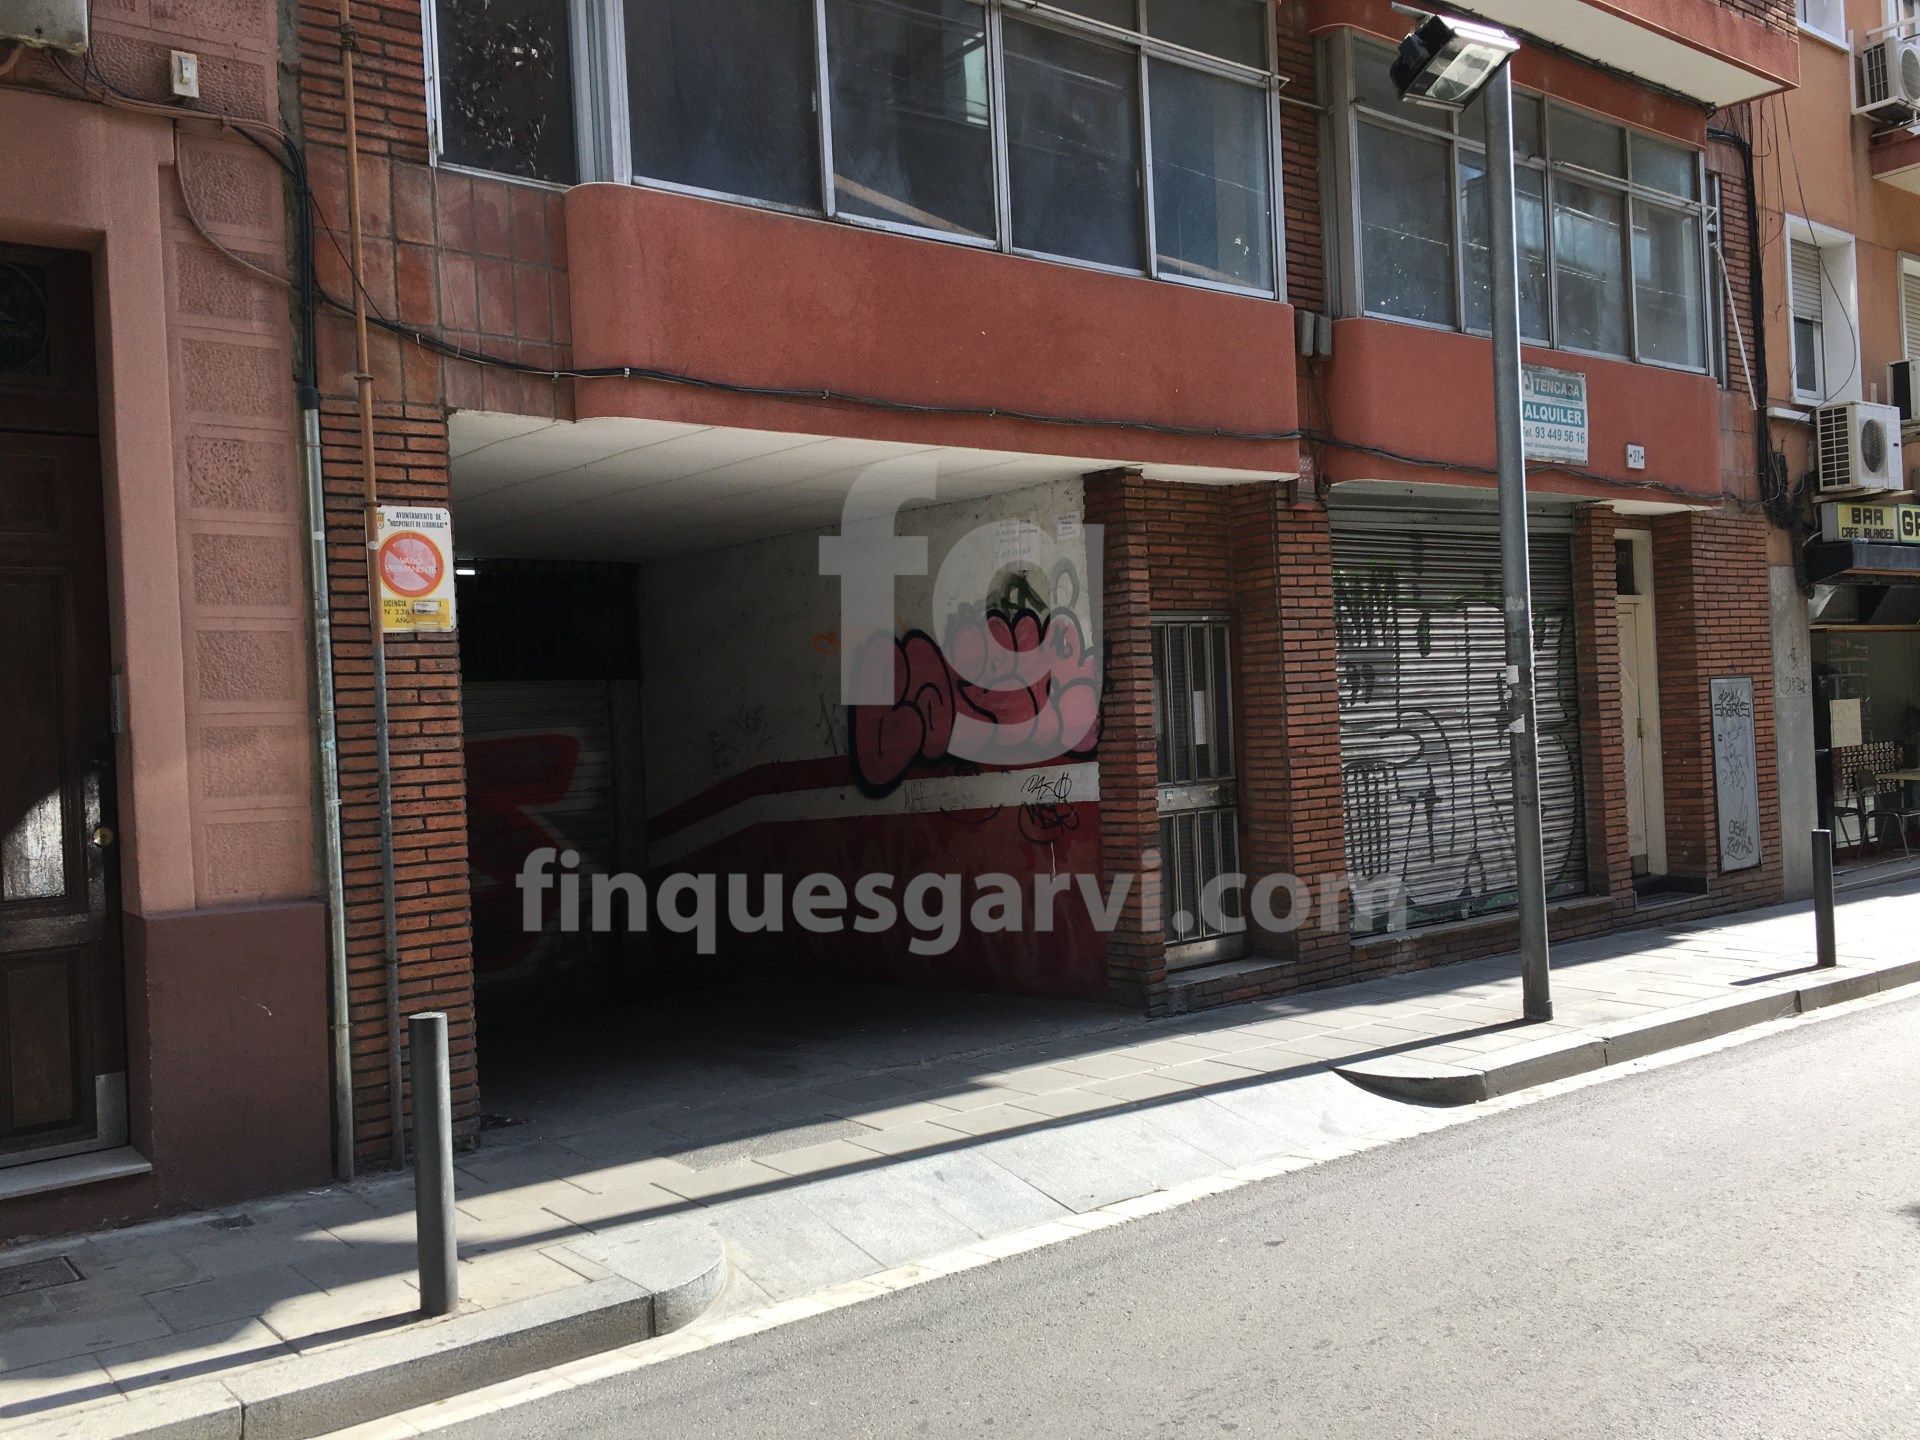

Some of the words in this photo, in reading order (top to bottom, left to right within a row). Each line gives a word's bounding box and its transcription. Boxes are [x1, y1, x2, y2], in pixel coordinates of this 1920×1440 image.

[1524, 404, 1582, 425] ALQUILER
[1535, 427, 1545, 439] 93
[1547, 428, 1562, 441] 449
[1564, 430, 1574, 443] 56
[1576, 432, 1585, 444] 16
[395, 512, 433, 520] AYUNTAMIENTO
[1852, 507, 1883, 525] BAR
[1841, 527, 1859, 538] CAFE
[400, 556, 423, 565] VADO
